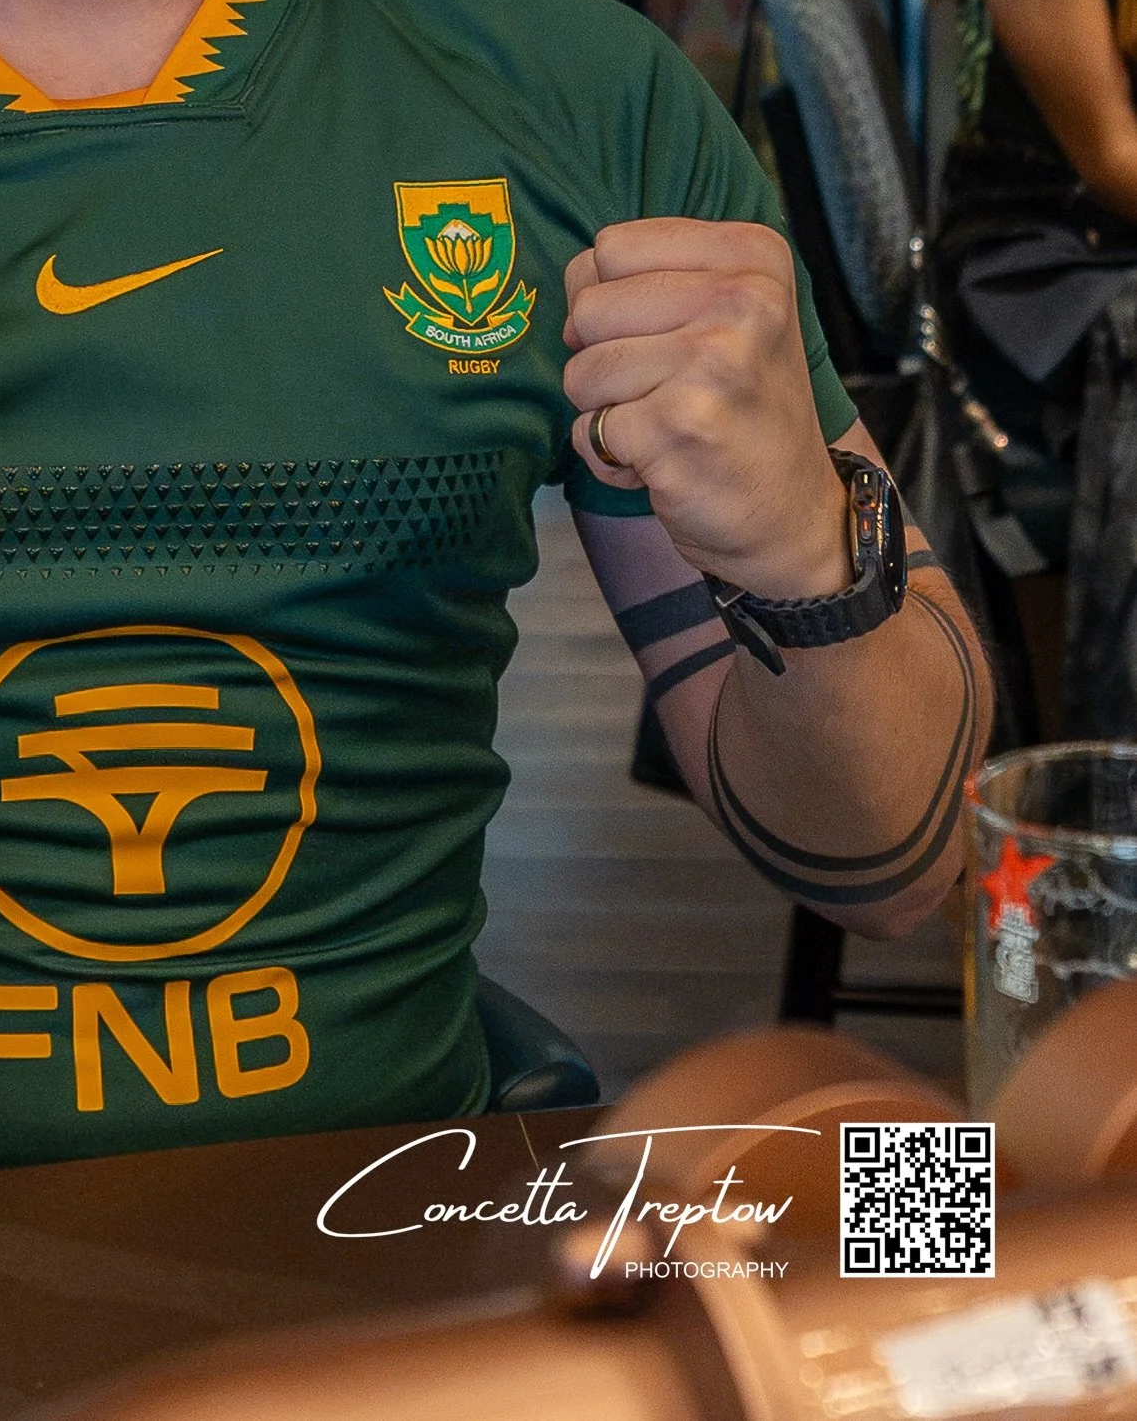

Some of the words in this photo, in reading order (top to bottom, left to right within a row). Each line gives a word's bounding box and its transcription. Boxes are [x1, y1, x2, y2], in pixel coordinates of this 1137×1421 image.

[425, 325, 471, 348] SOUTH
[474, 324, 517, 347] AFRICA
[448, 359, 501, 375] RUGBY
